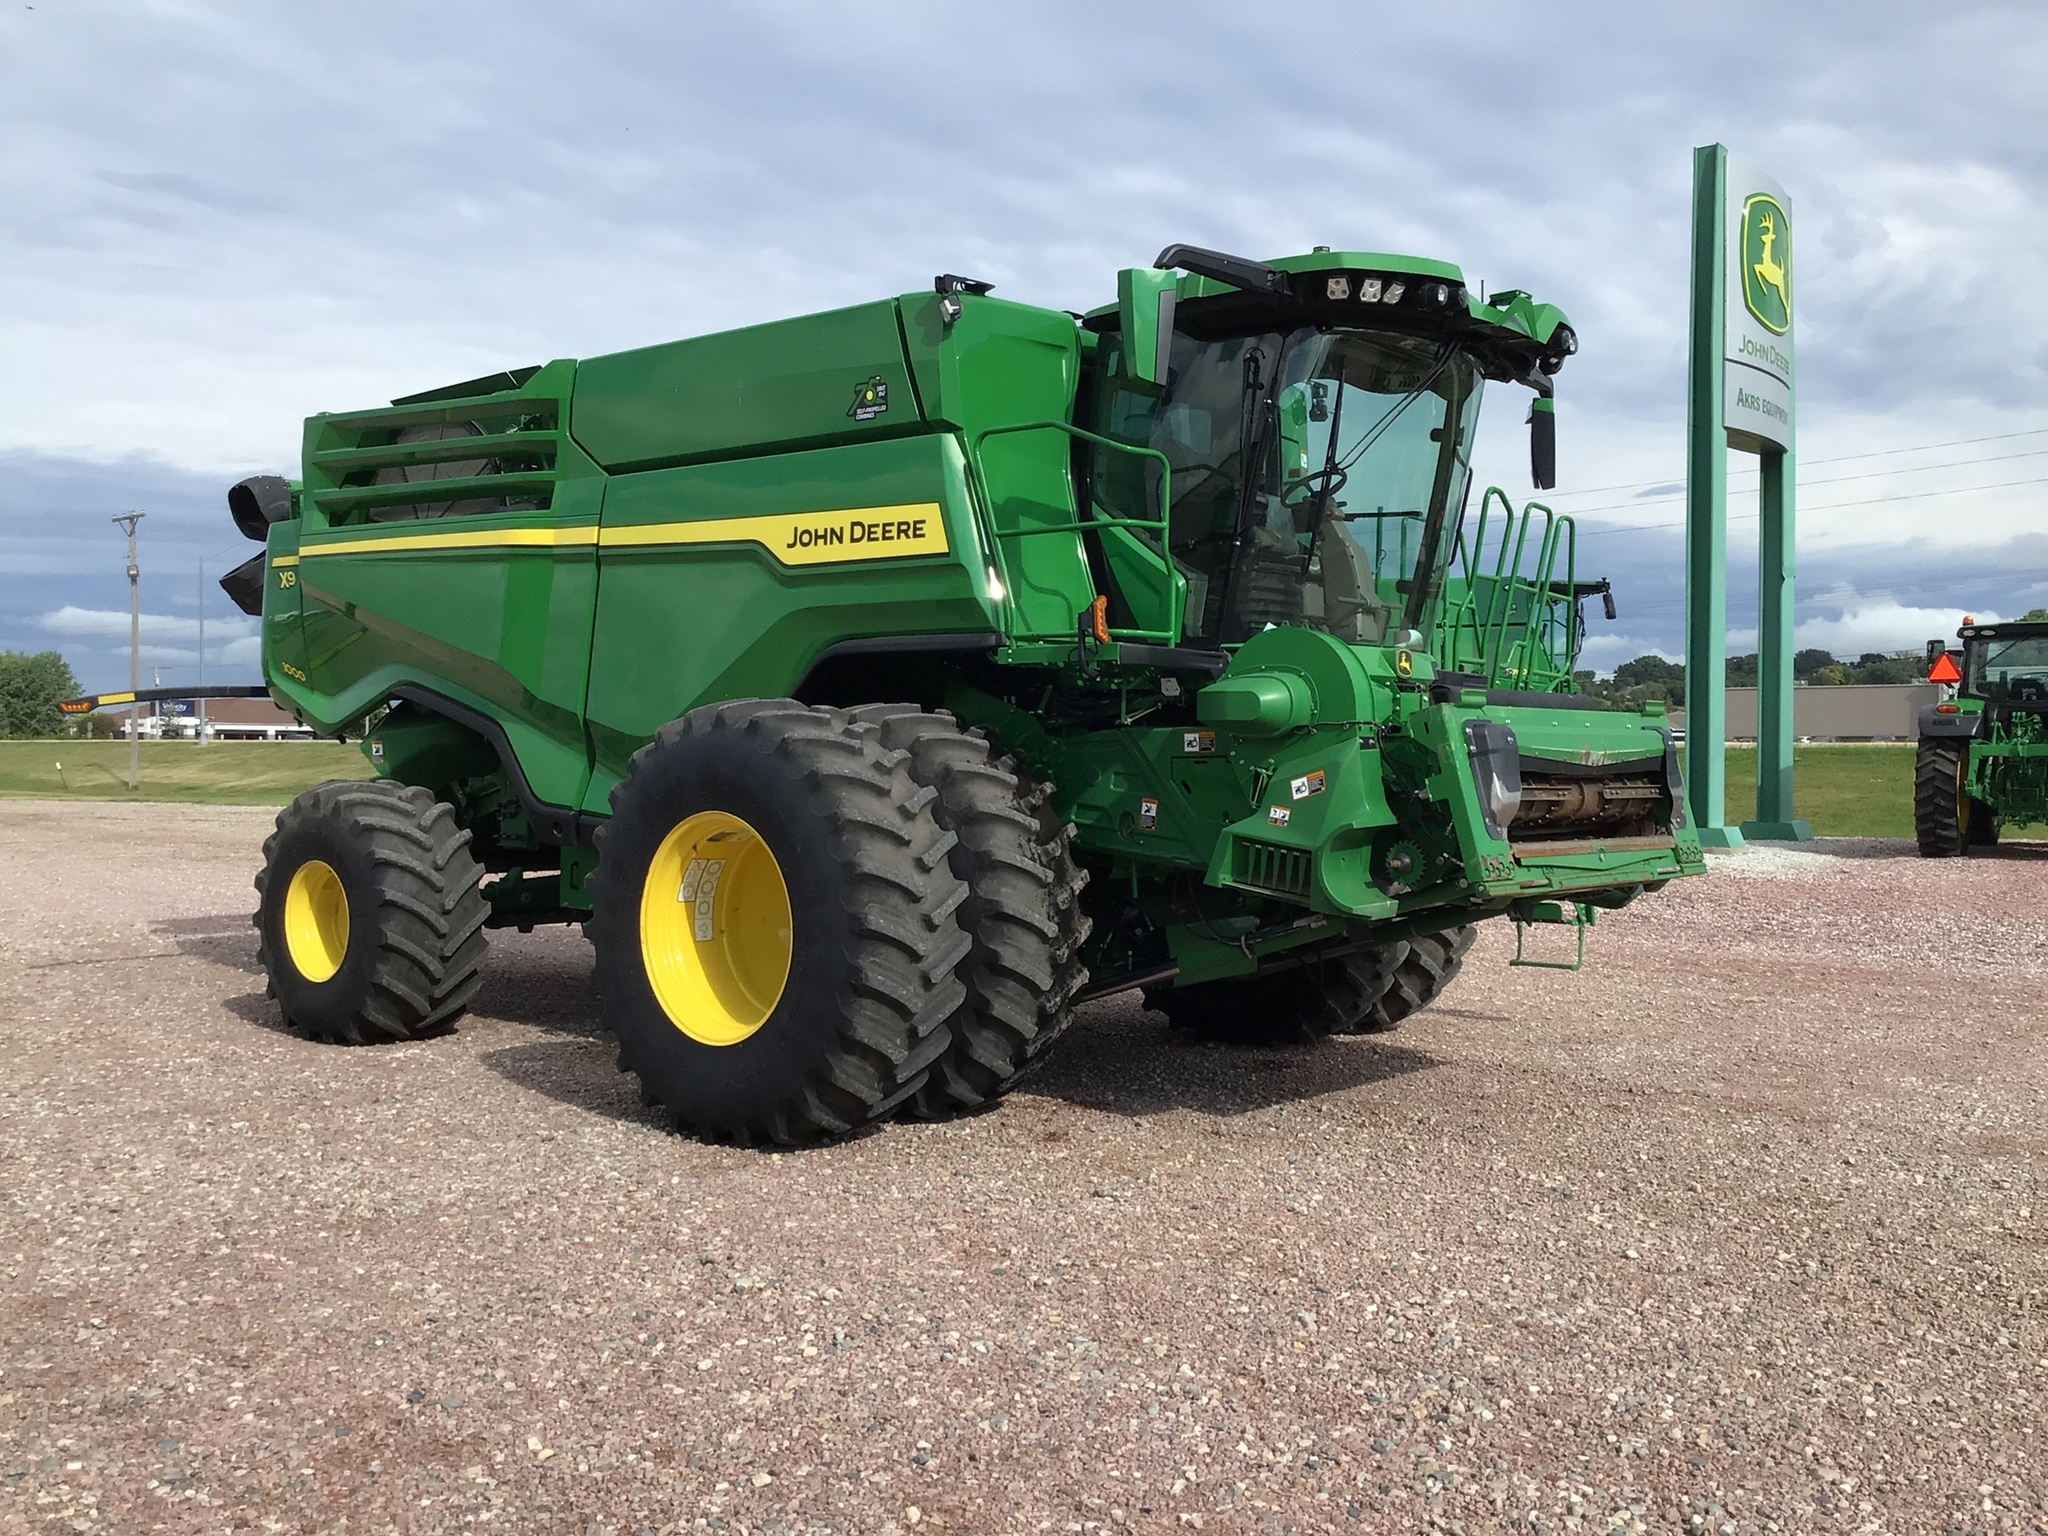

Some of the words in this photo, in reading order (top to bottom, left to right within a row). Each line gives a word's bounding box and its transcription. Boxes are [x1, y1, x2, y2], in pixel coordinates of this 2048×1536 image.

[1738, 334, 1769, 362] JOHN
[1736, 387, 1761, 412] AKRS
[786, 526, 844, 549] JOHN
[849, 519, 927, 544] DEERE
[279, 571, 296, 589] X9
[282, 661, 307, 682] 1000
